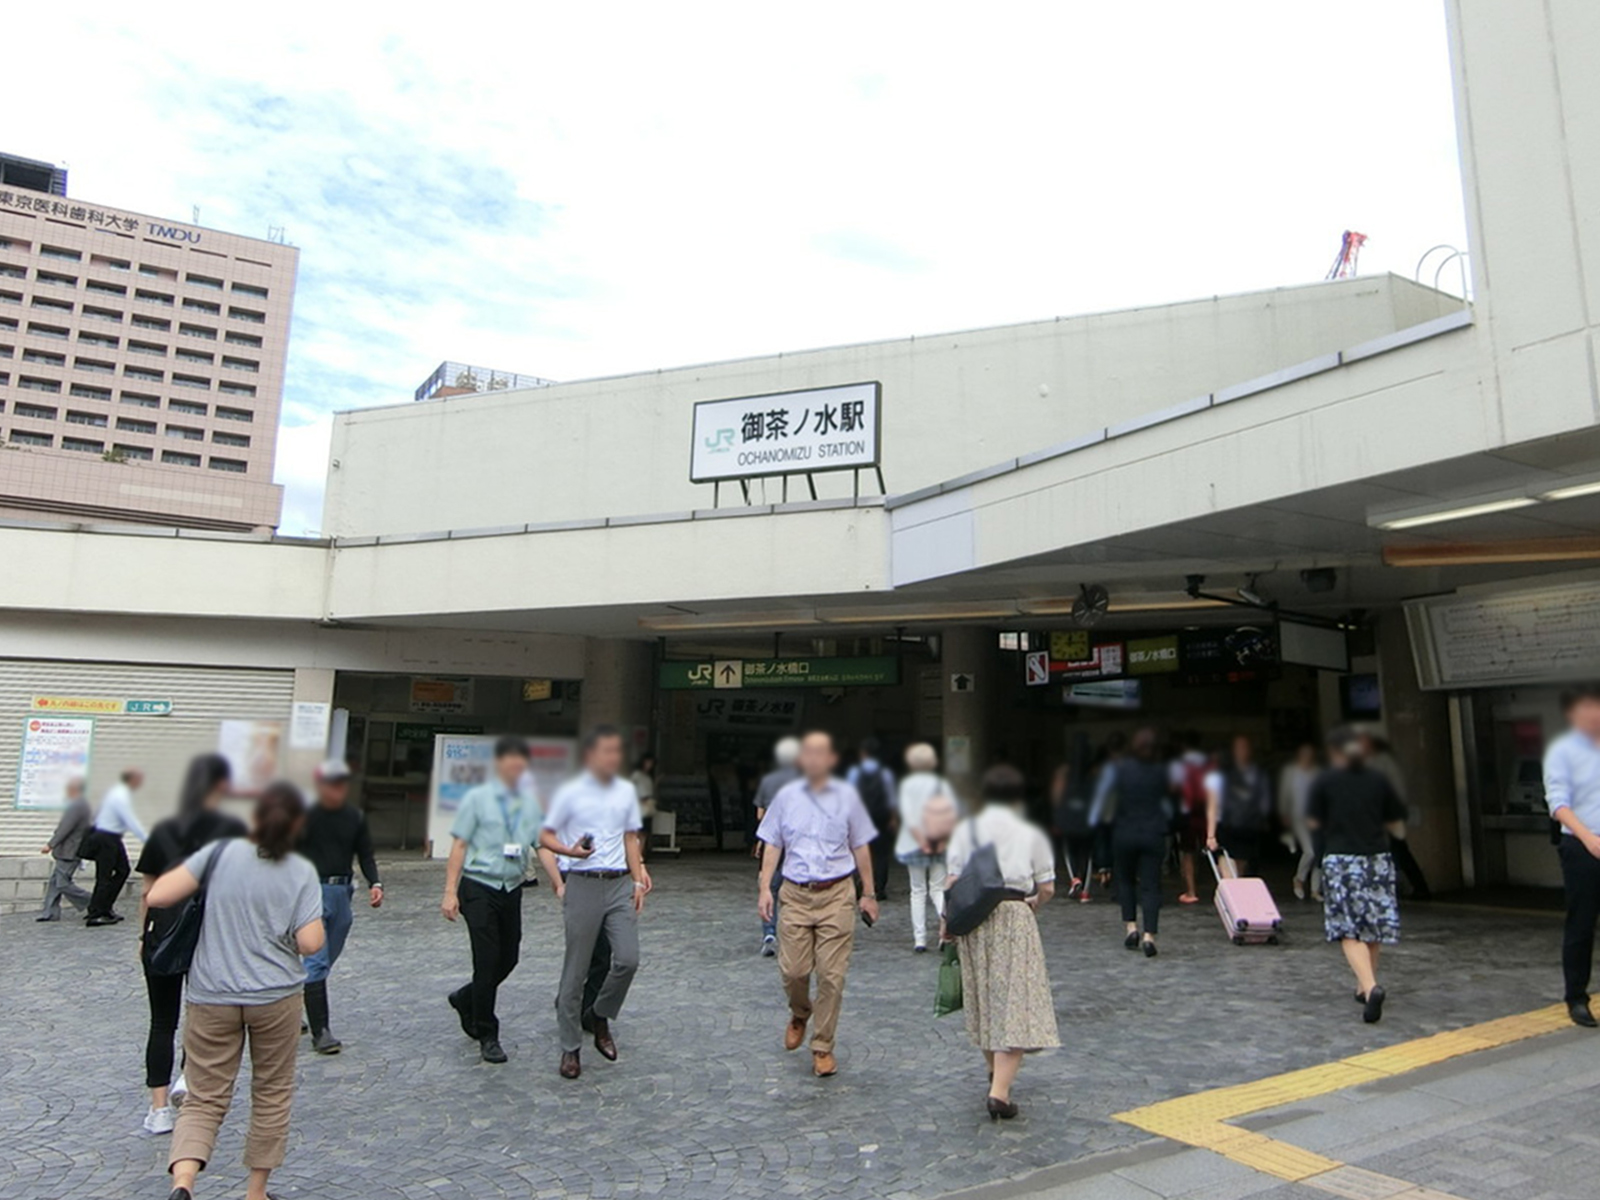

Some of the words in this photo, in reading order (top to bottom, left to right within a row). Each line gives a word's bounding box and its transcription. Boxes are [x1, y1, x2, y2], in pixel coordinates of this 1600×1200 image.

[0, 191, 139, 232] 東京医科歯科大学
[148, 222, 201, 243] TMDU
[705, 428, 736, 448] JR
[741, 400, 865, 443] 御茶ノ水駅
[738, 446, 812, 466] OCHANOMIZU
[817, 440, 865, 459] STATION
[688, 664, 713, 680] JR
[744, 662, 809, 675] 御茶ノ水橋口
